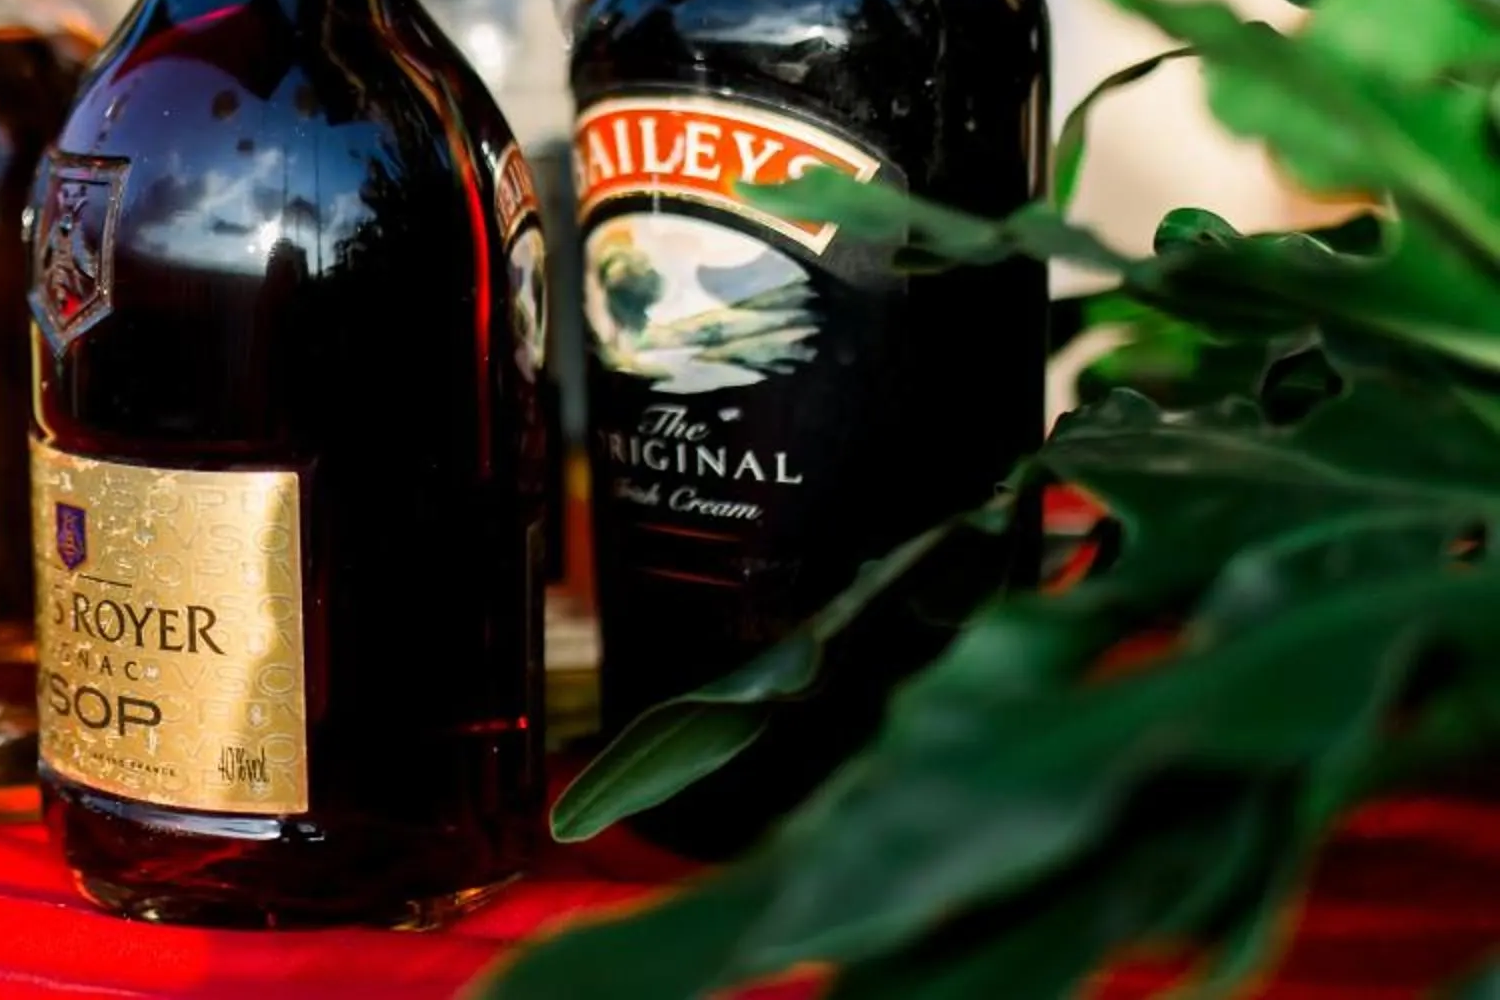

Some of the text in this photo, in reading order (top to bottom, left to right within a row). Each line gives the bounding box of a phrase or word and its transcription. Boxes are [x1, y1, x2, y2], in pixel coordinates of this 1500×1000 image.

[574, 115, 828, 188] AILEY
[638, 404, 709, 441] The
[599, 429, 803, 484] RIGINAL
[669, 486, 763, 520] Cream
[73, 592, 227, 655] ROYER
[45, 670, 162, 736] SOP
